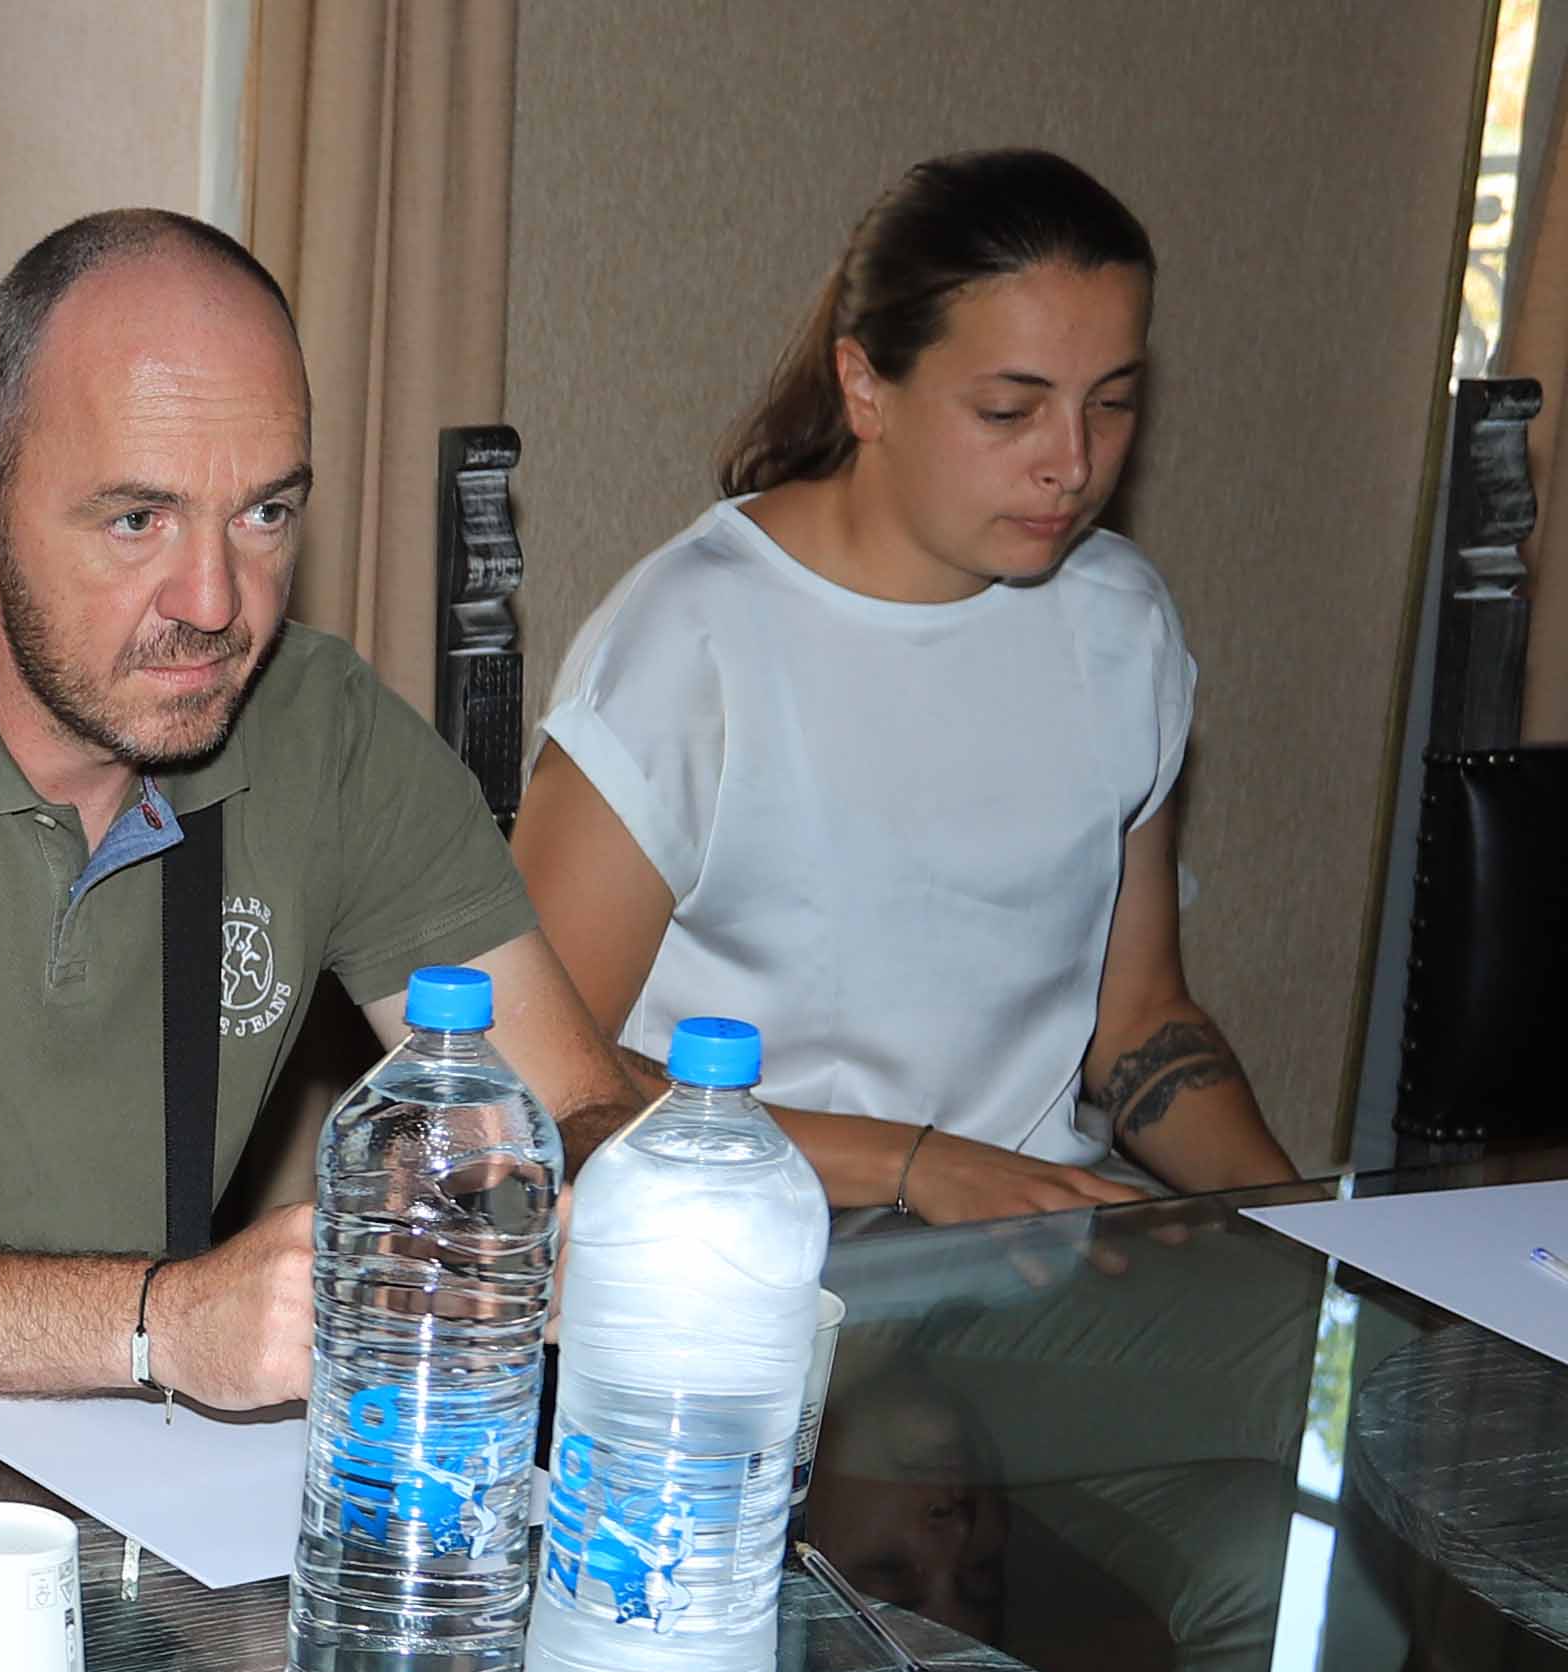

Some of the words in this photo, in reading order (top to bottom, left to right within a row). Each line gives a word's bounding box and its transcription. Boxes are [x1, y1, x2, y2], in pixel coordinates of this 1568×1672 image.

[222, 896, 273, 926] ARS
[235, 981, 292, 1038] JEANS
[328, 1383, 402, 1544] zilia
[546, 1433, 594, 1601] zilia
